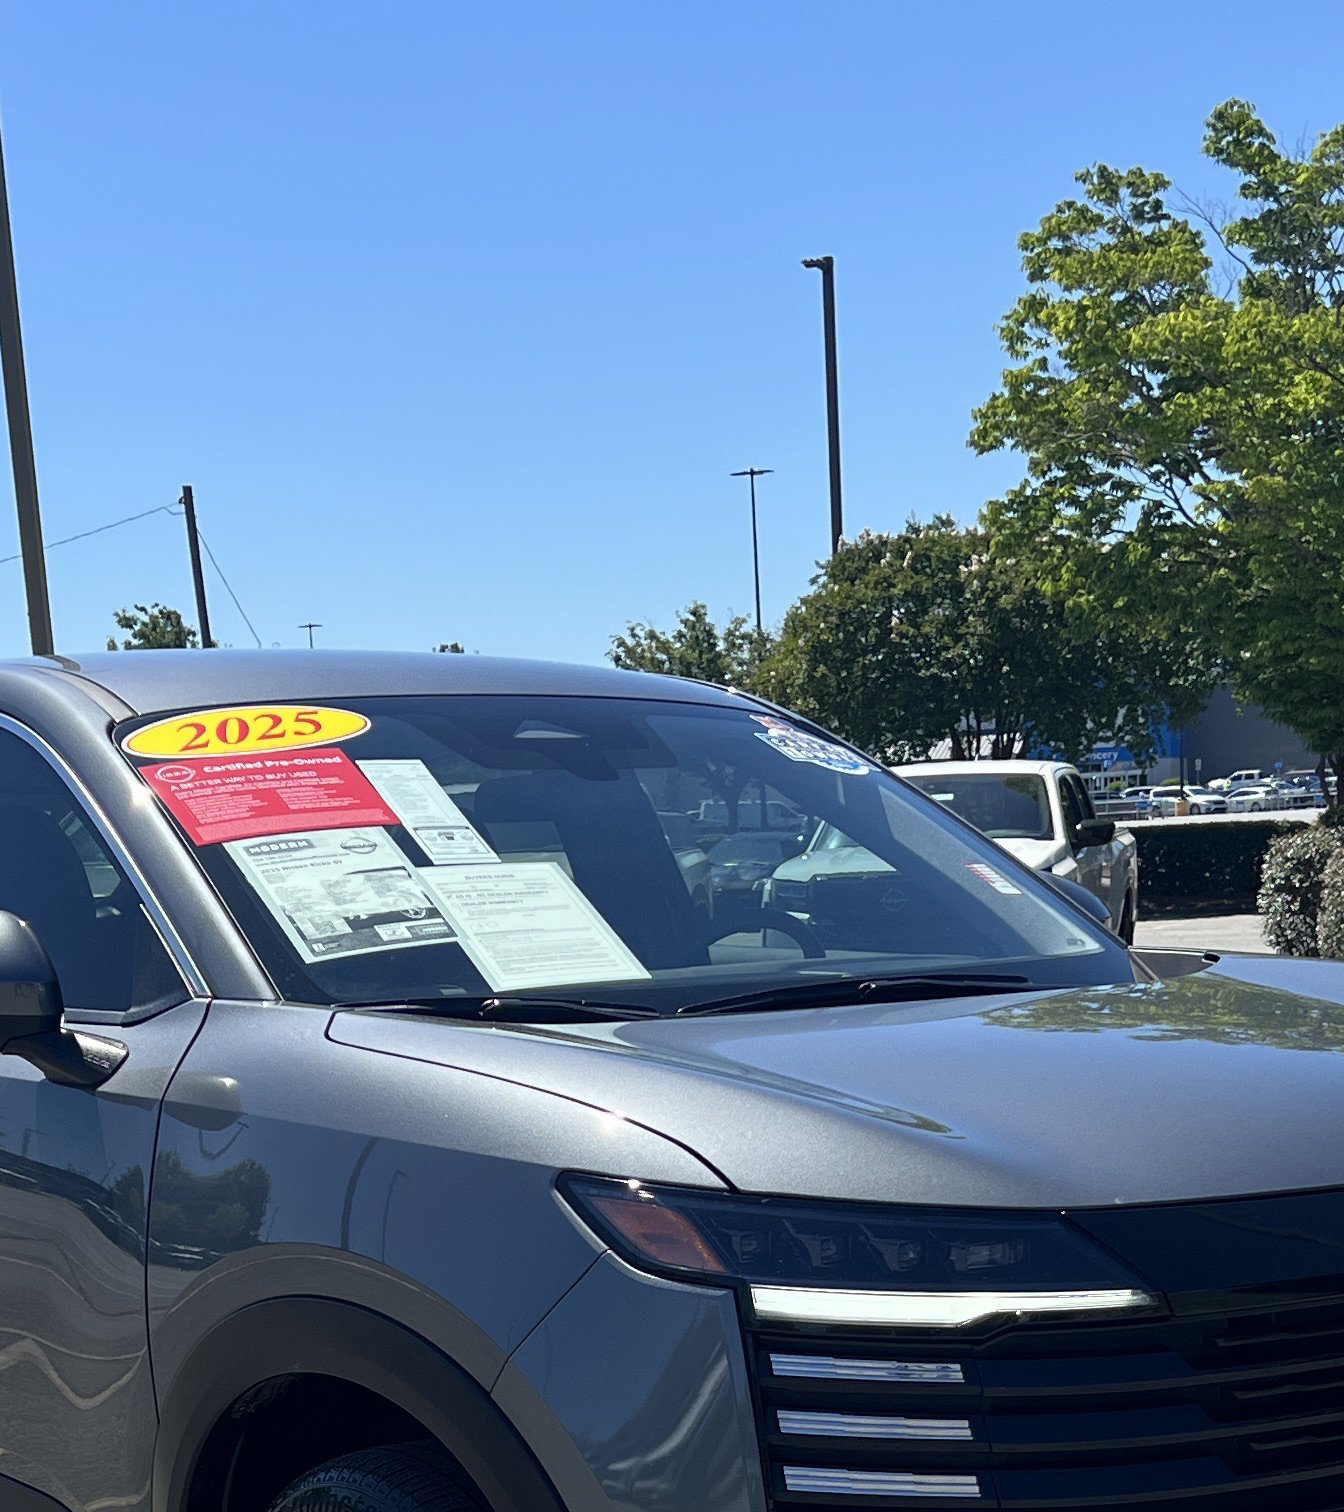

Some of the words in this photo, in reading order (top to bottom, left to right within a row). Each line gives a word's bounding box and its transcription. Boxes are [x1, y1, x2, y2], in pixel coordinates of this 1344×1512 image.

[175, 710, 323, 752] 2025
[202, 761, 263, 773] Certified
[264, 756, 343, 768] Pre-Owned
[179, 778, 223, 789] BETTER
[265, 772, 287, 780] BUY
[289, 770, 318, 778] USED
[249, 841, 309, 854] MODERN
